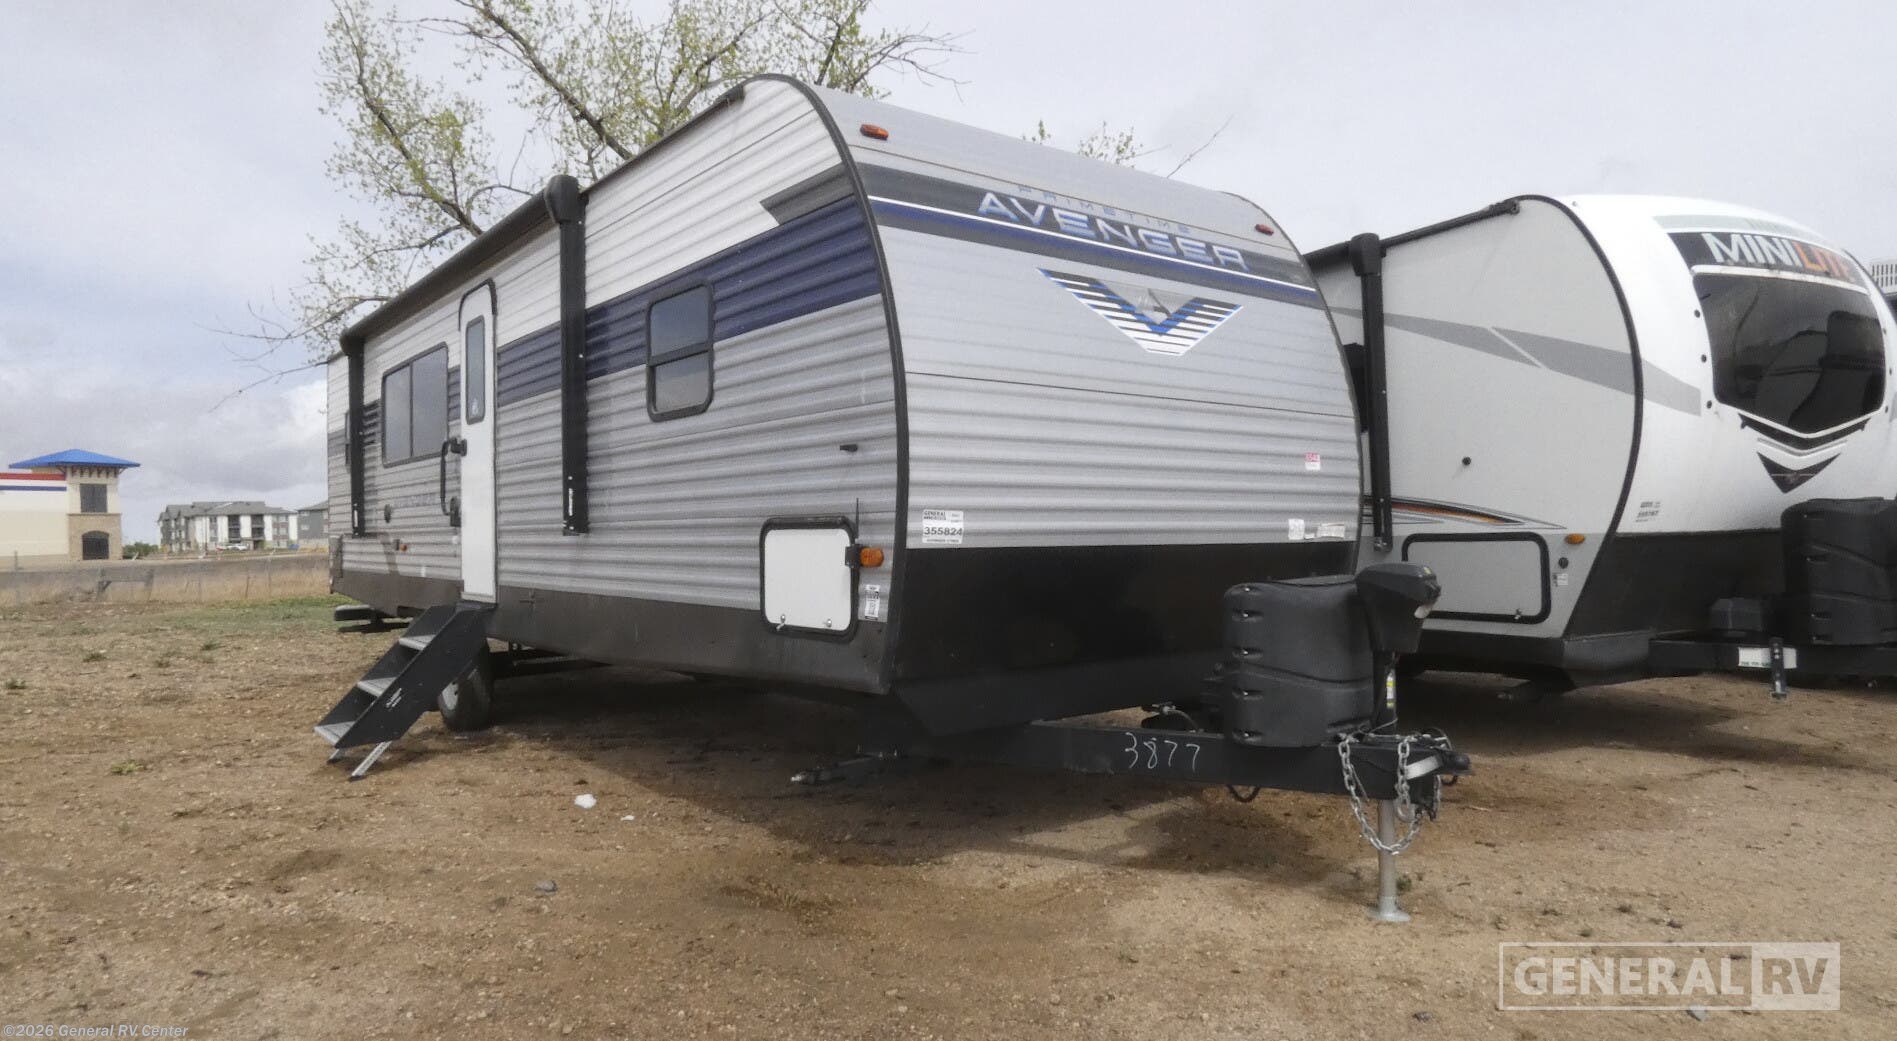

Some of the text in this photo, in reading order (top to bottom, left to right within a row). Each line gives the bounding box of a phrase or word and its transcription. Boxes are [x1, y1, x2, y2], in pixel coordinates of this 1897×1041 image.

[977, 191, 1250, 272] AVENGER
[923, 526, 963, 536] 355824
[1124, 731, 1200, 771] 3877
